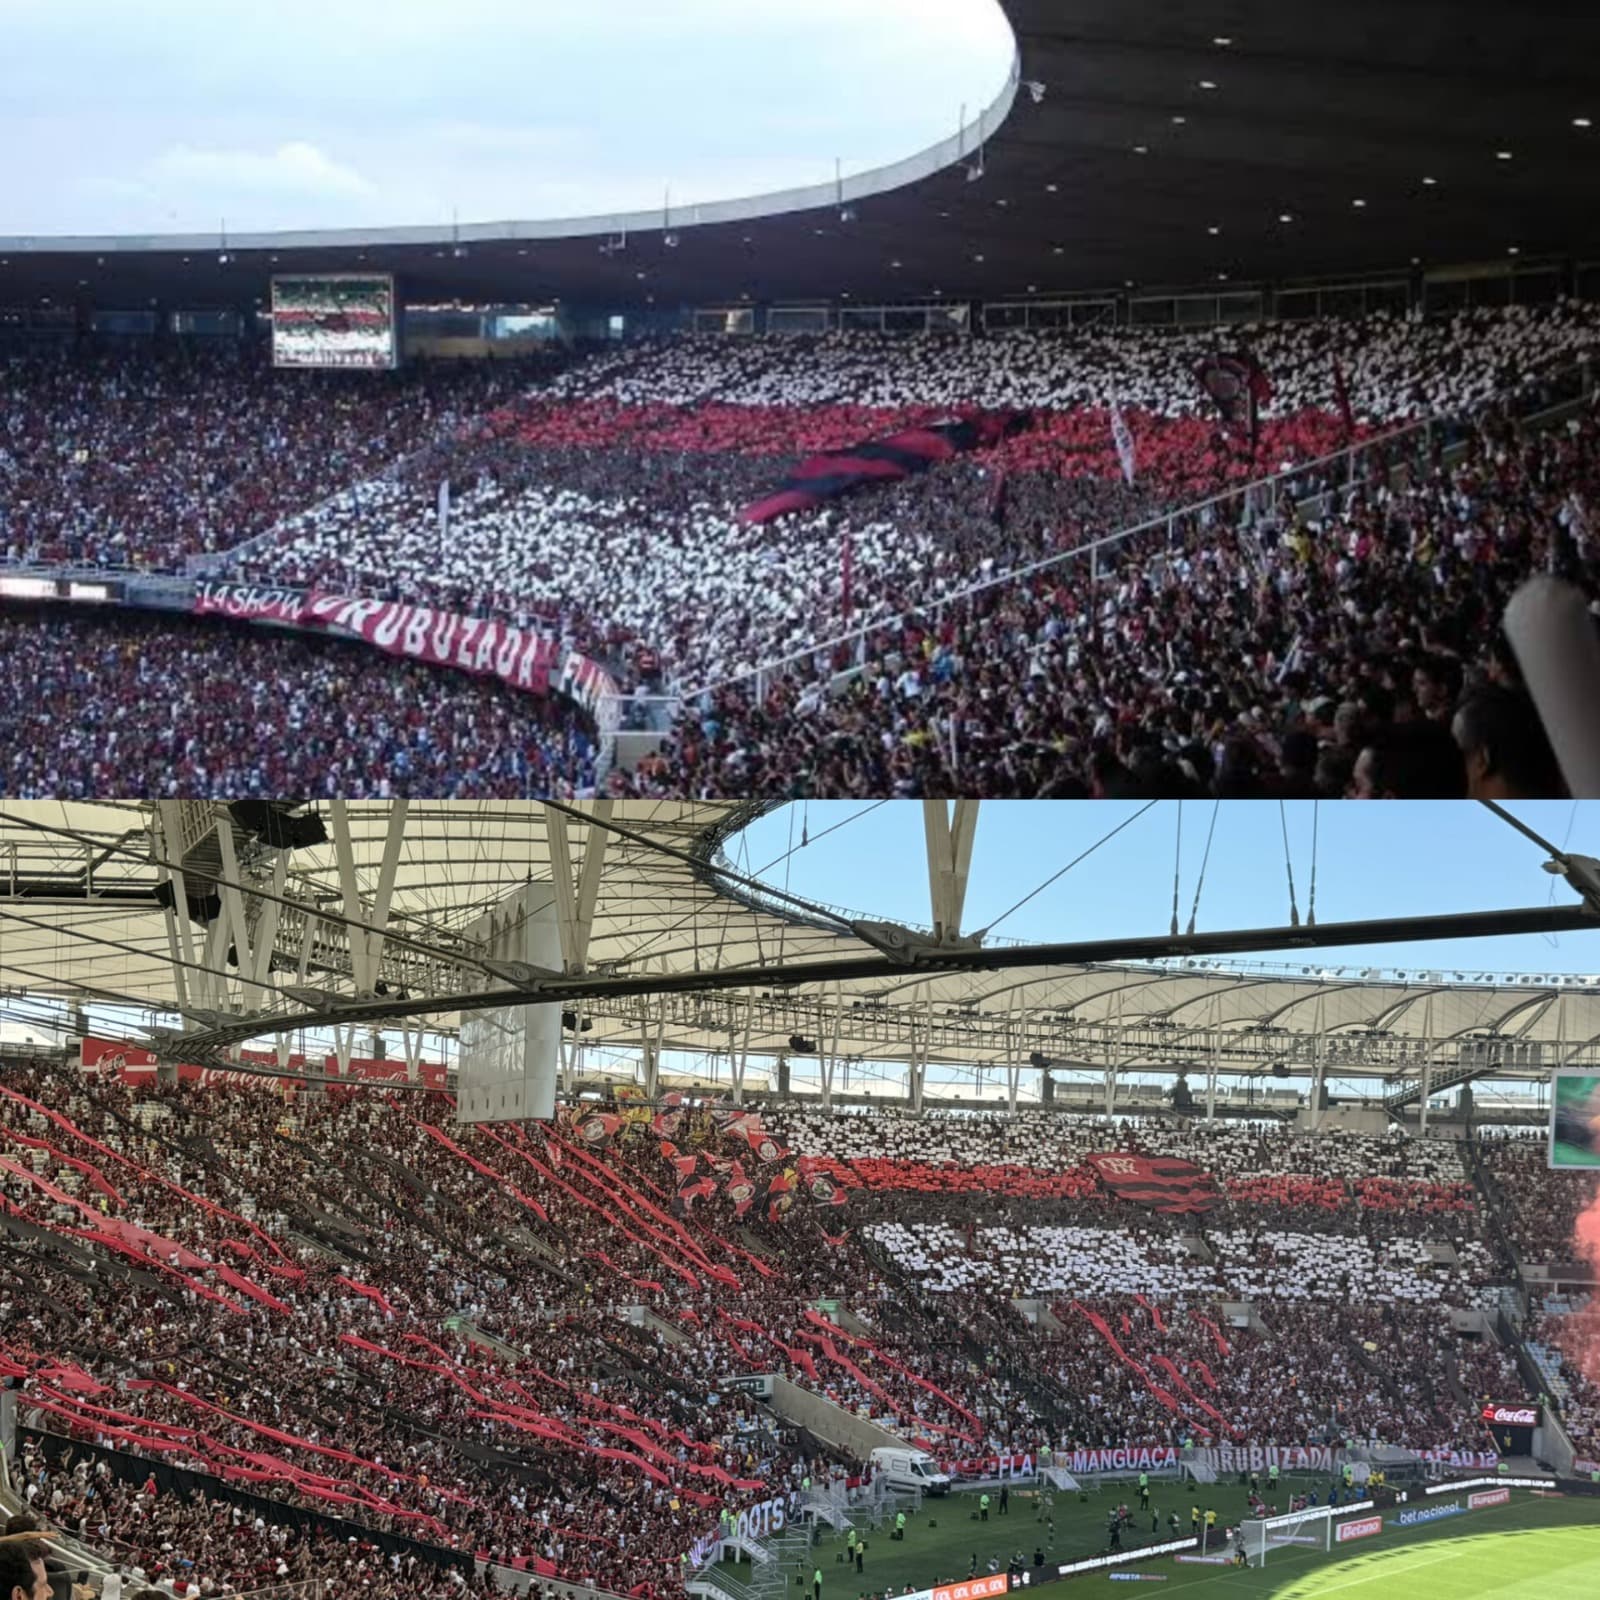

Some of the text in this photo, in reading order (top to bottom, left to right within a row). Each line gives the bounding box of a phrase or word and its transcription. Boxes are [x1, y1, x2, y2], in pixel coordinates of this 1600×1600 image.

[312, 595, 538, 687] URUBUZADA
[1494, 1408, 1537, 1423] Coca-Cola
[1000, 1447, 1178, 1478] FLA MANGUAÇA
[1204, 1447, 1332, 1472] URUBUZADA
[1343, 1522, 1378, 1537] Betano
